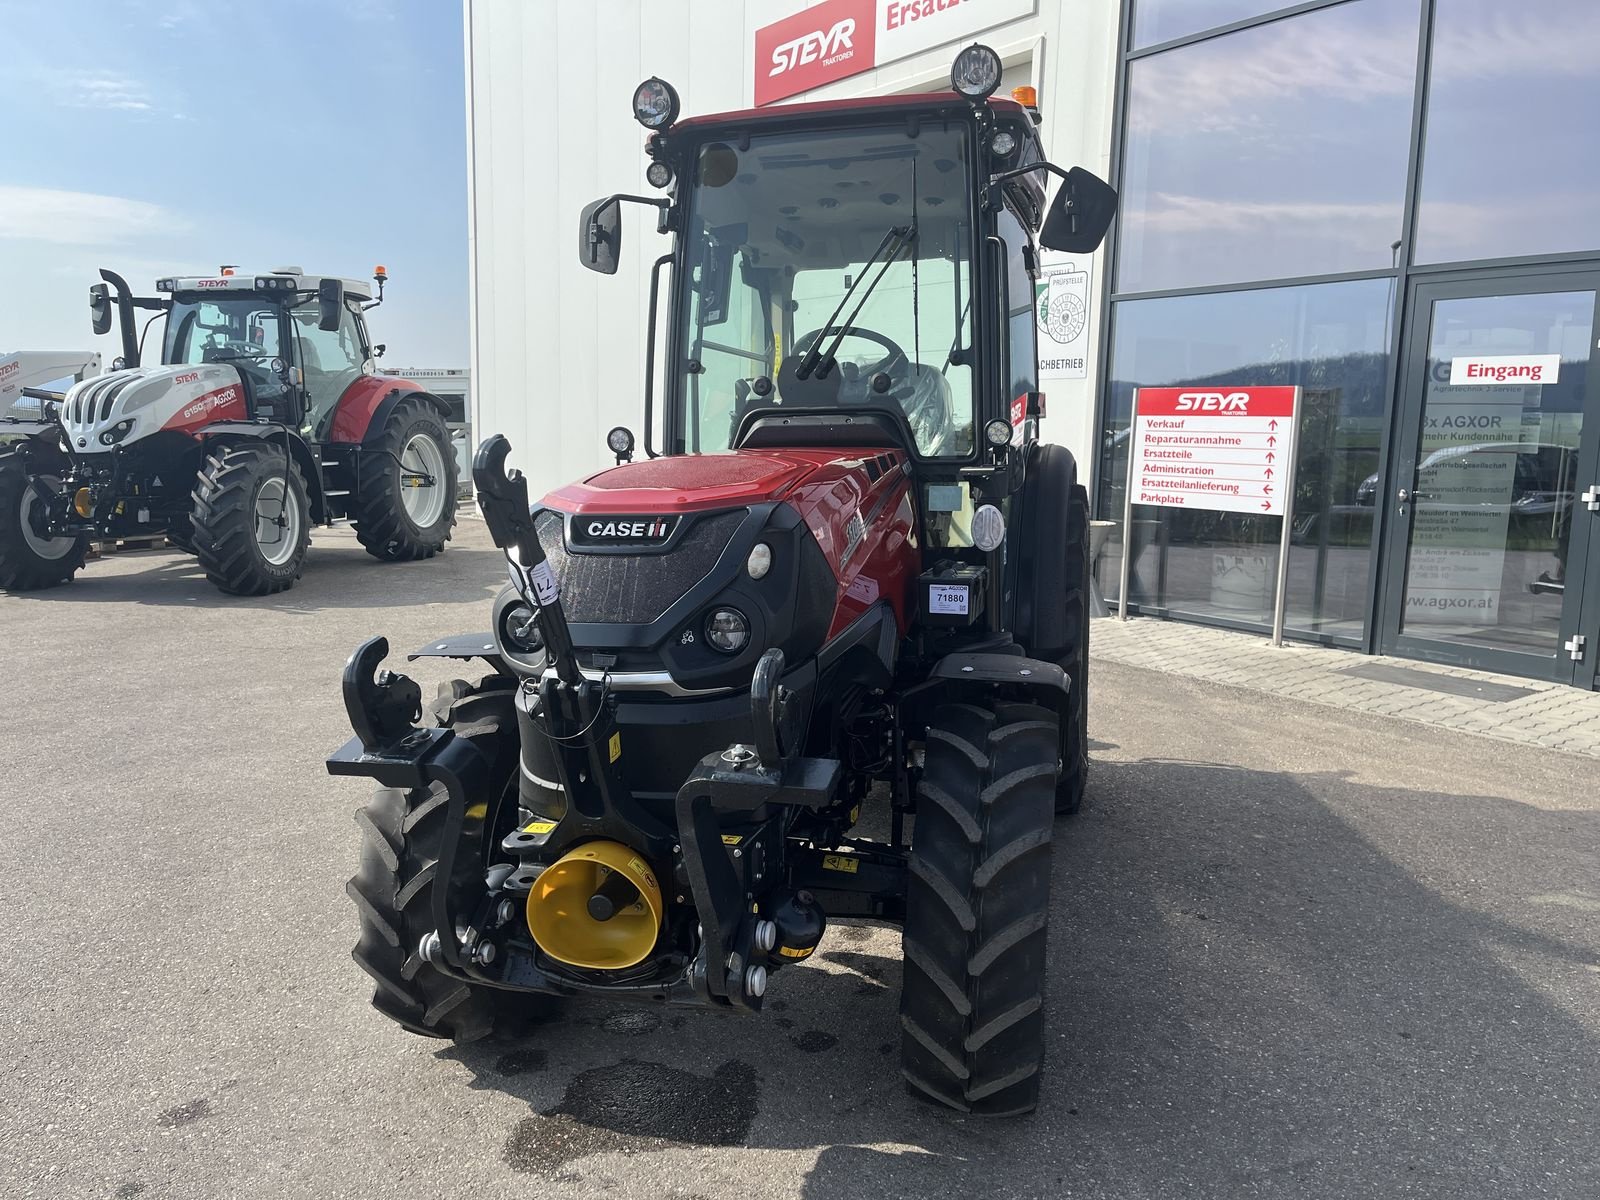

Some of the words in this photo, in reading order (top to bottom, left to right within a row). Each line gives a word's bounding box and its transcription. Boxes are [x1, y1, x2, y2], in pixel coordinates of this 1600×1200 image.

[769, 18, 856, 77] STEYR
[822, 50, 854, 66] TRAKTOREN
[197, 280, 229, 288] STEYR
[0, 361, 19, 376] TEYR
[1039, 358, 1083, 370] CHBETRIEB
[176, 372, 199, 385] STEYR
[1467, 363, 1543, 381] Eingang
[1175, 393, 1250, 411] STEYR
[1147, 419, 1185, 428] Verkauf
[1442, 415, 1502, 428] AGXOR
[1145, 434, 1241, 445] Reparaturannahme
[1144, 449, 1193, 459] Ersatzteile
[1143, 464, 1214, 475] Administration
[1142, 479, 1239, 494] Ersatzteilanlieferung
[1141, 493, 1185, 504] Parkplatz
[588, 522, 645, 537] CASE
[937, 594, 964, 602] 71880
